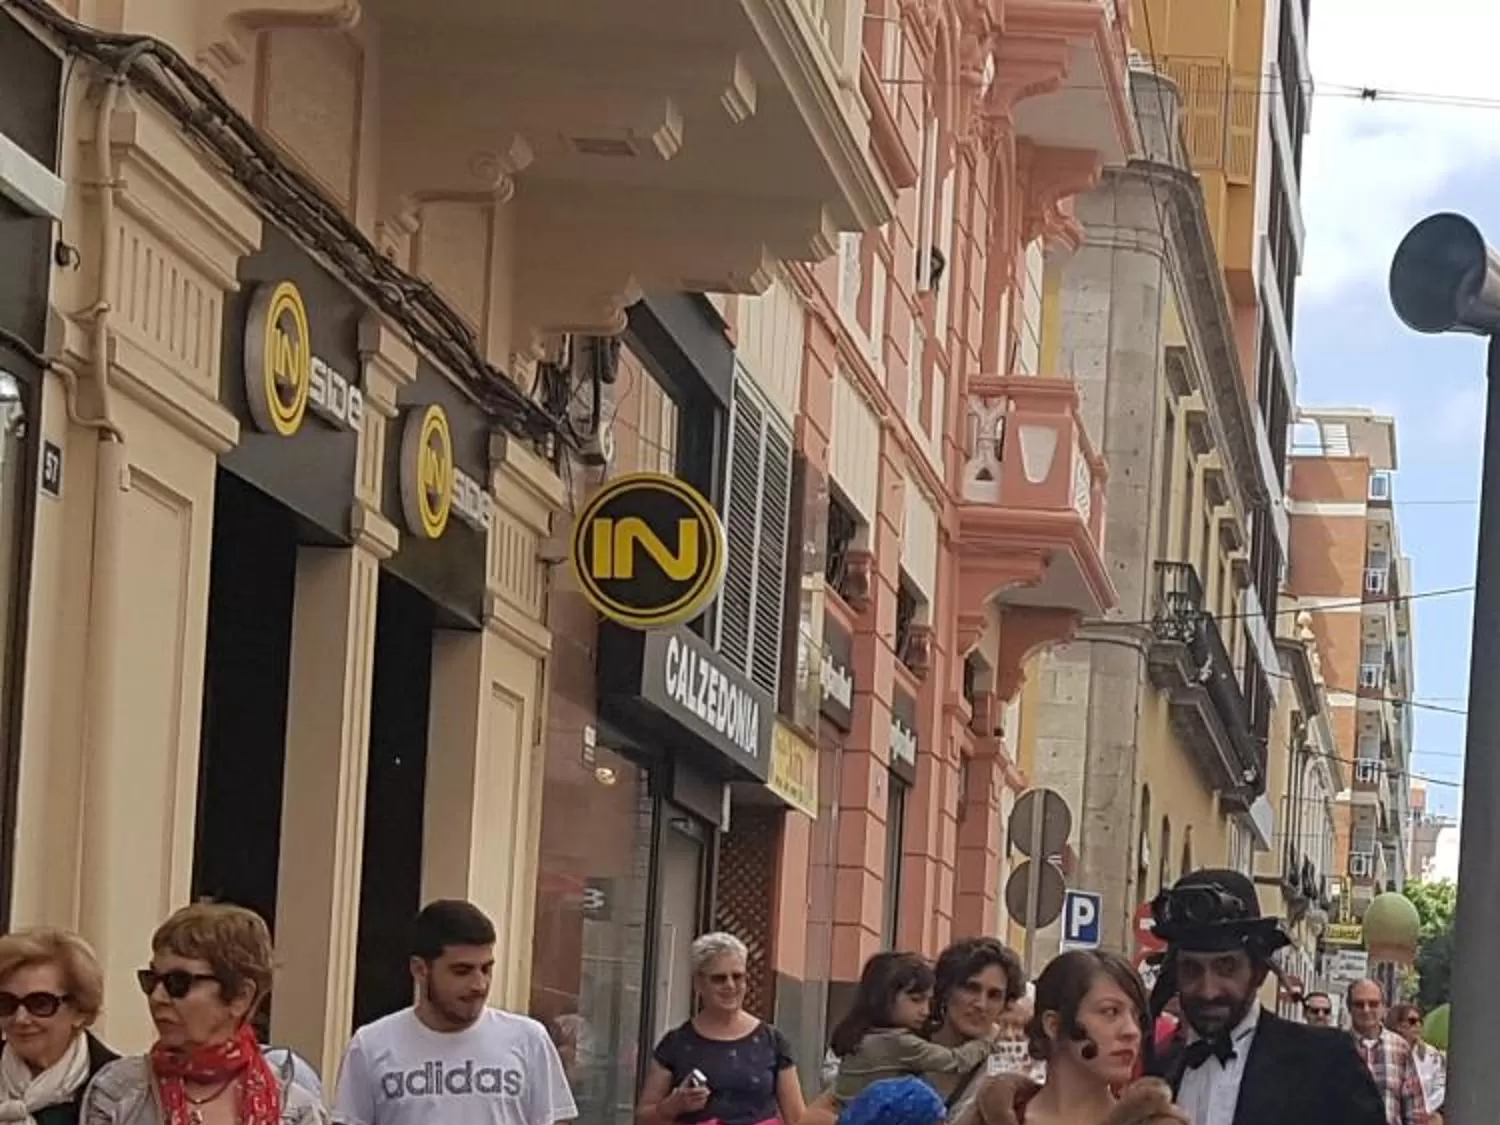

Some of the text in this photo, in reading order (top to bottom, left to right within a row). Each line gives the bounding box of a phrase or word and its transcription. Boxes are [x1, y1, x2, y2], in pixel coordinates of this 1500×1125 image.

[45, 451, 59, 484] 57
[593, 516, 698, 581] IN
[665, 635, 761, 758] CALZEDONIA
[1071, 895, 1096, 938] P
[381, 1060, 522, 1099] adidas
